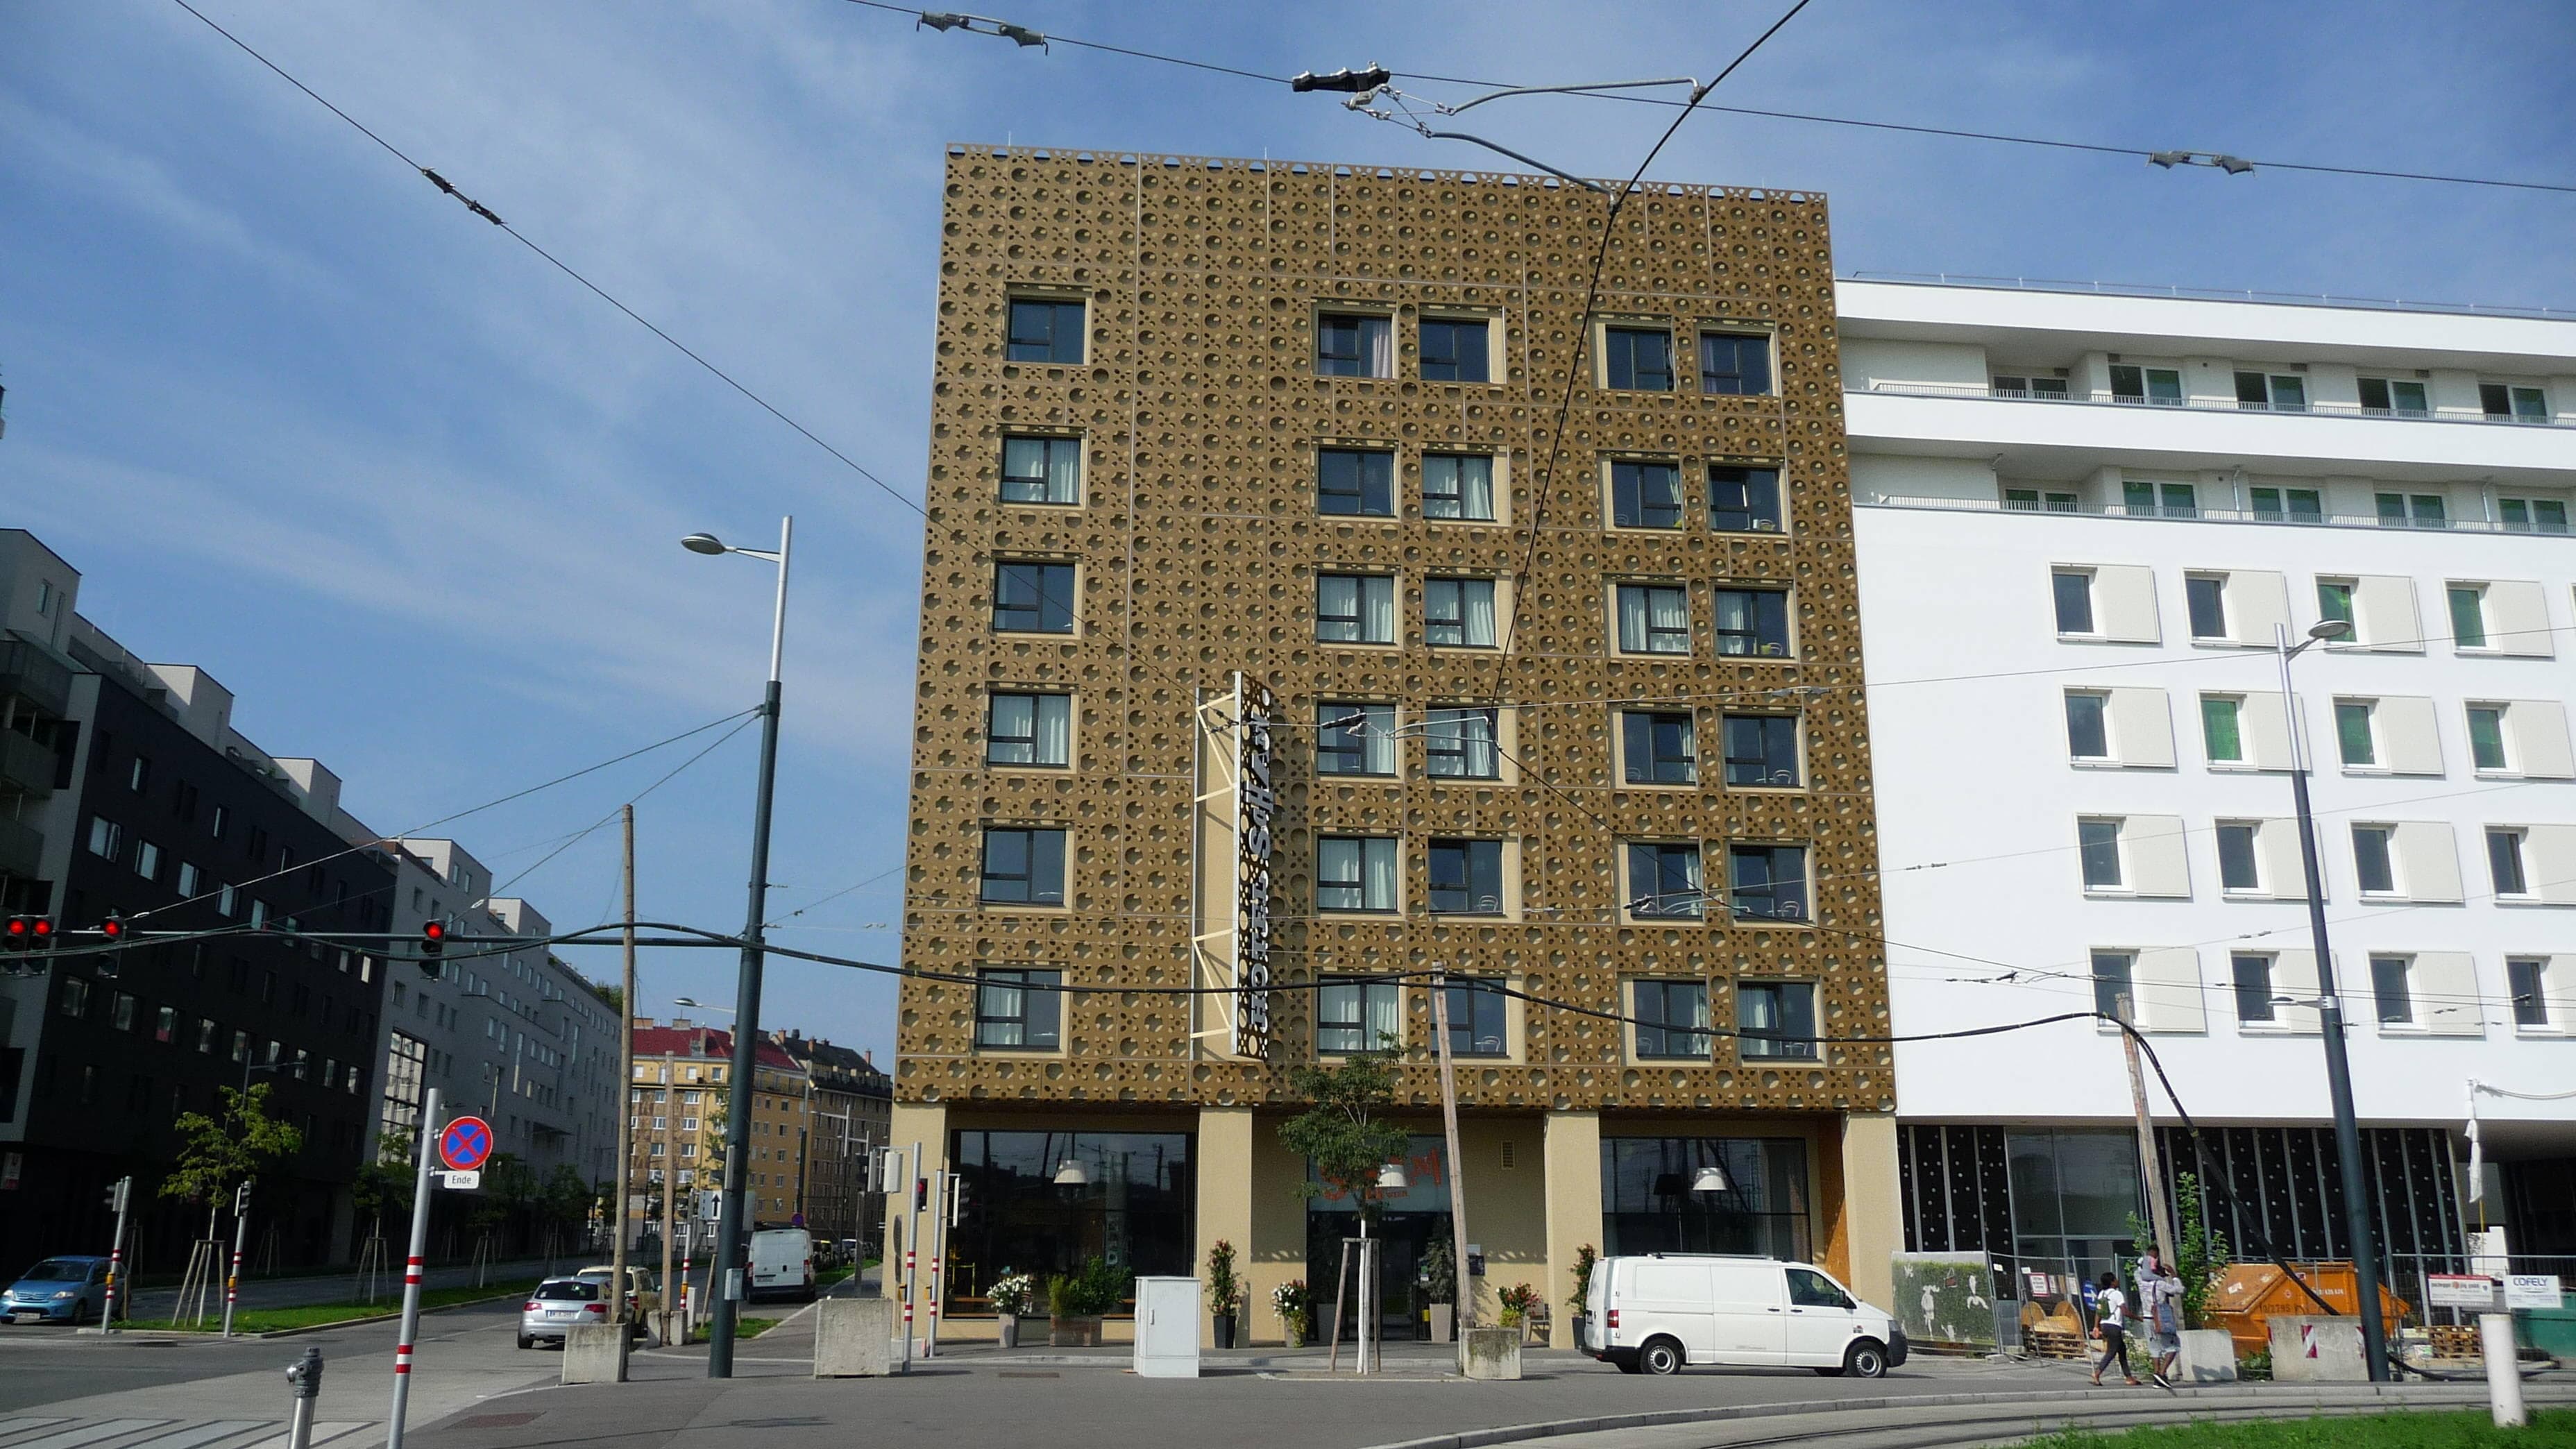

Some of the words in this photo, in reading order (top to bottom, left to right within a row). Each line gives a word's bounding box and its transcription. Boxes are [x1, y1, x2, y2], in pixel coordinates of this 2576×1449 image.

[1251, 877, 1266, 1028] HOTEL
[452, 1175, 471, 1184] Ende
[2513, 1277, 2548, 1287] COFELY
